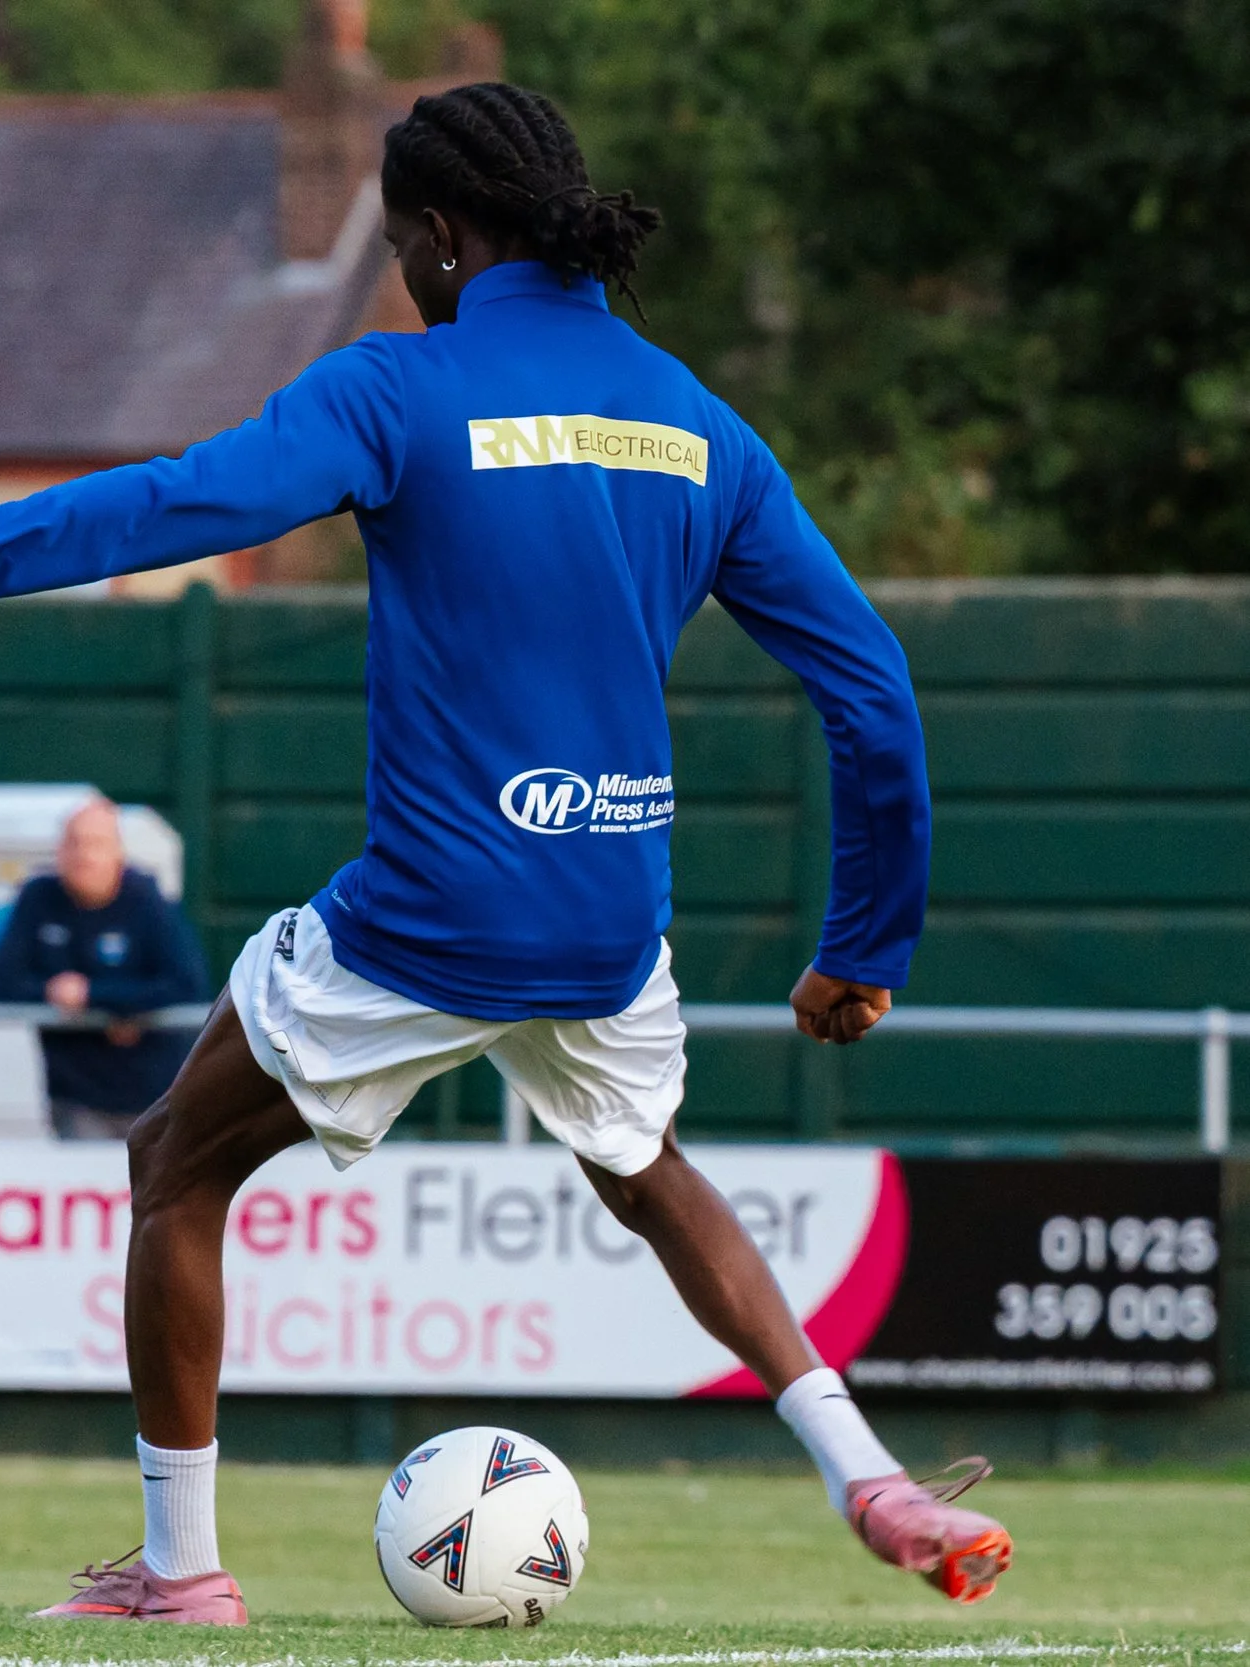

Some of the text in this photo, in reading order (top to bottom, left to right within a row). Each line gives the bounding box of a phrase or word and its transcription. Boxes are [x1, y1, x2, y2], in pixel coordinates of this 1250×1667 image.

[574, 429, 703, 473] ELECTRICAL
[591, 798, 644, 821] Press
[404, 1166, 817, 1264] Fletcer
[1040, 1215, 1218, 1274] 01925
[994, 1281, 1217, 1341] 359 005
